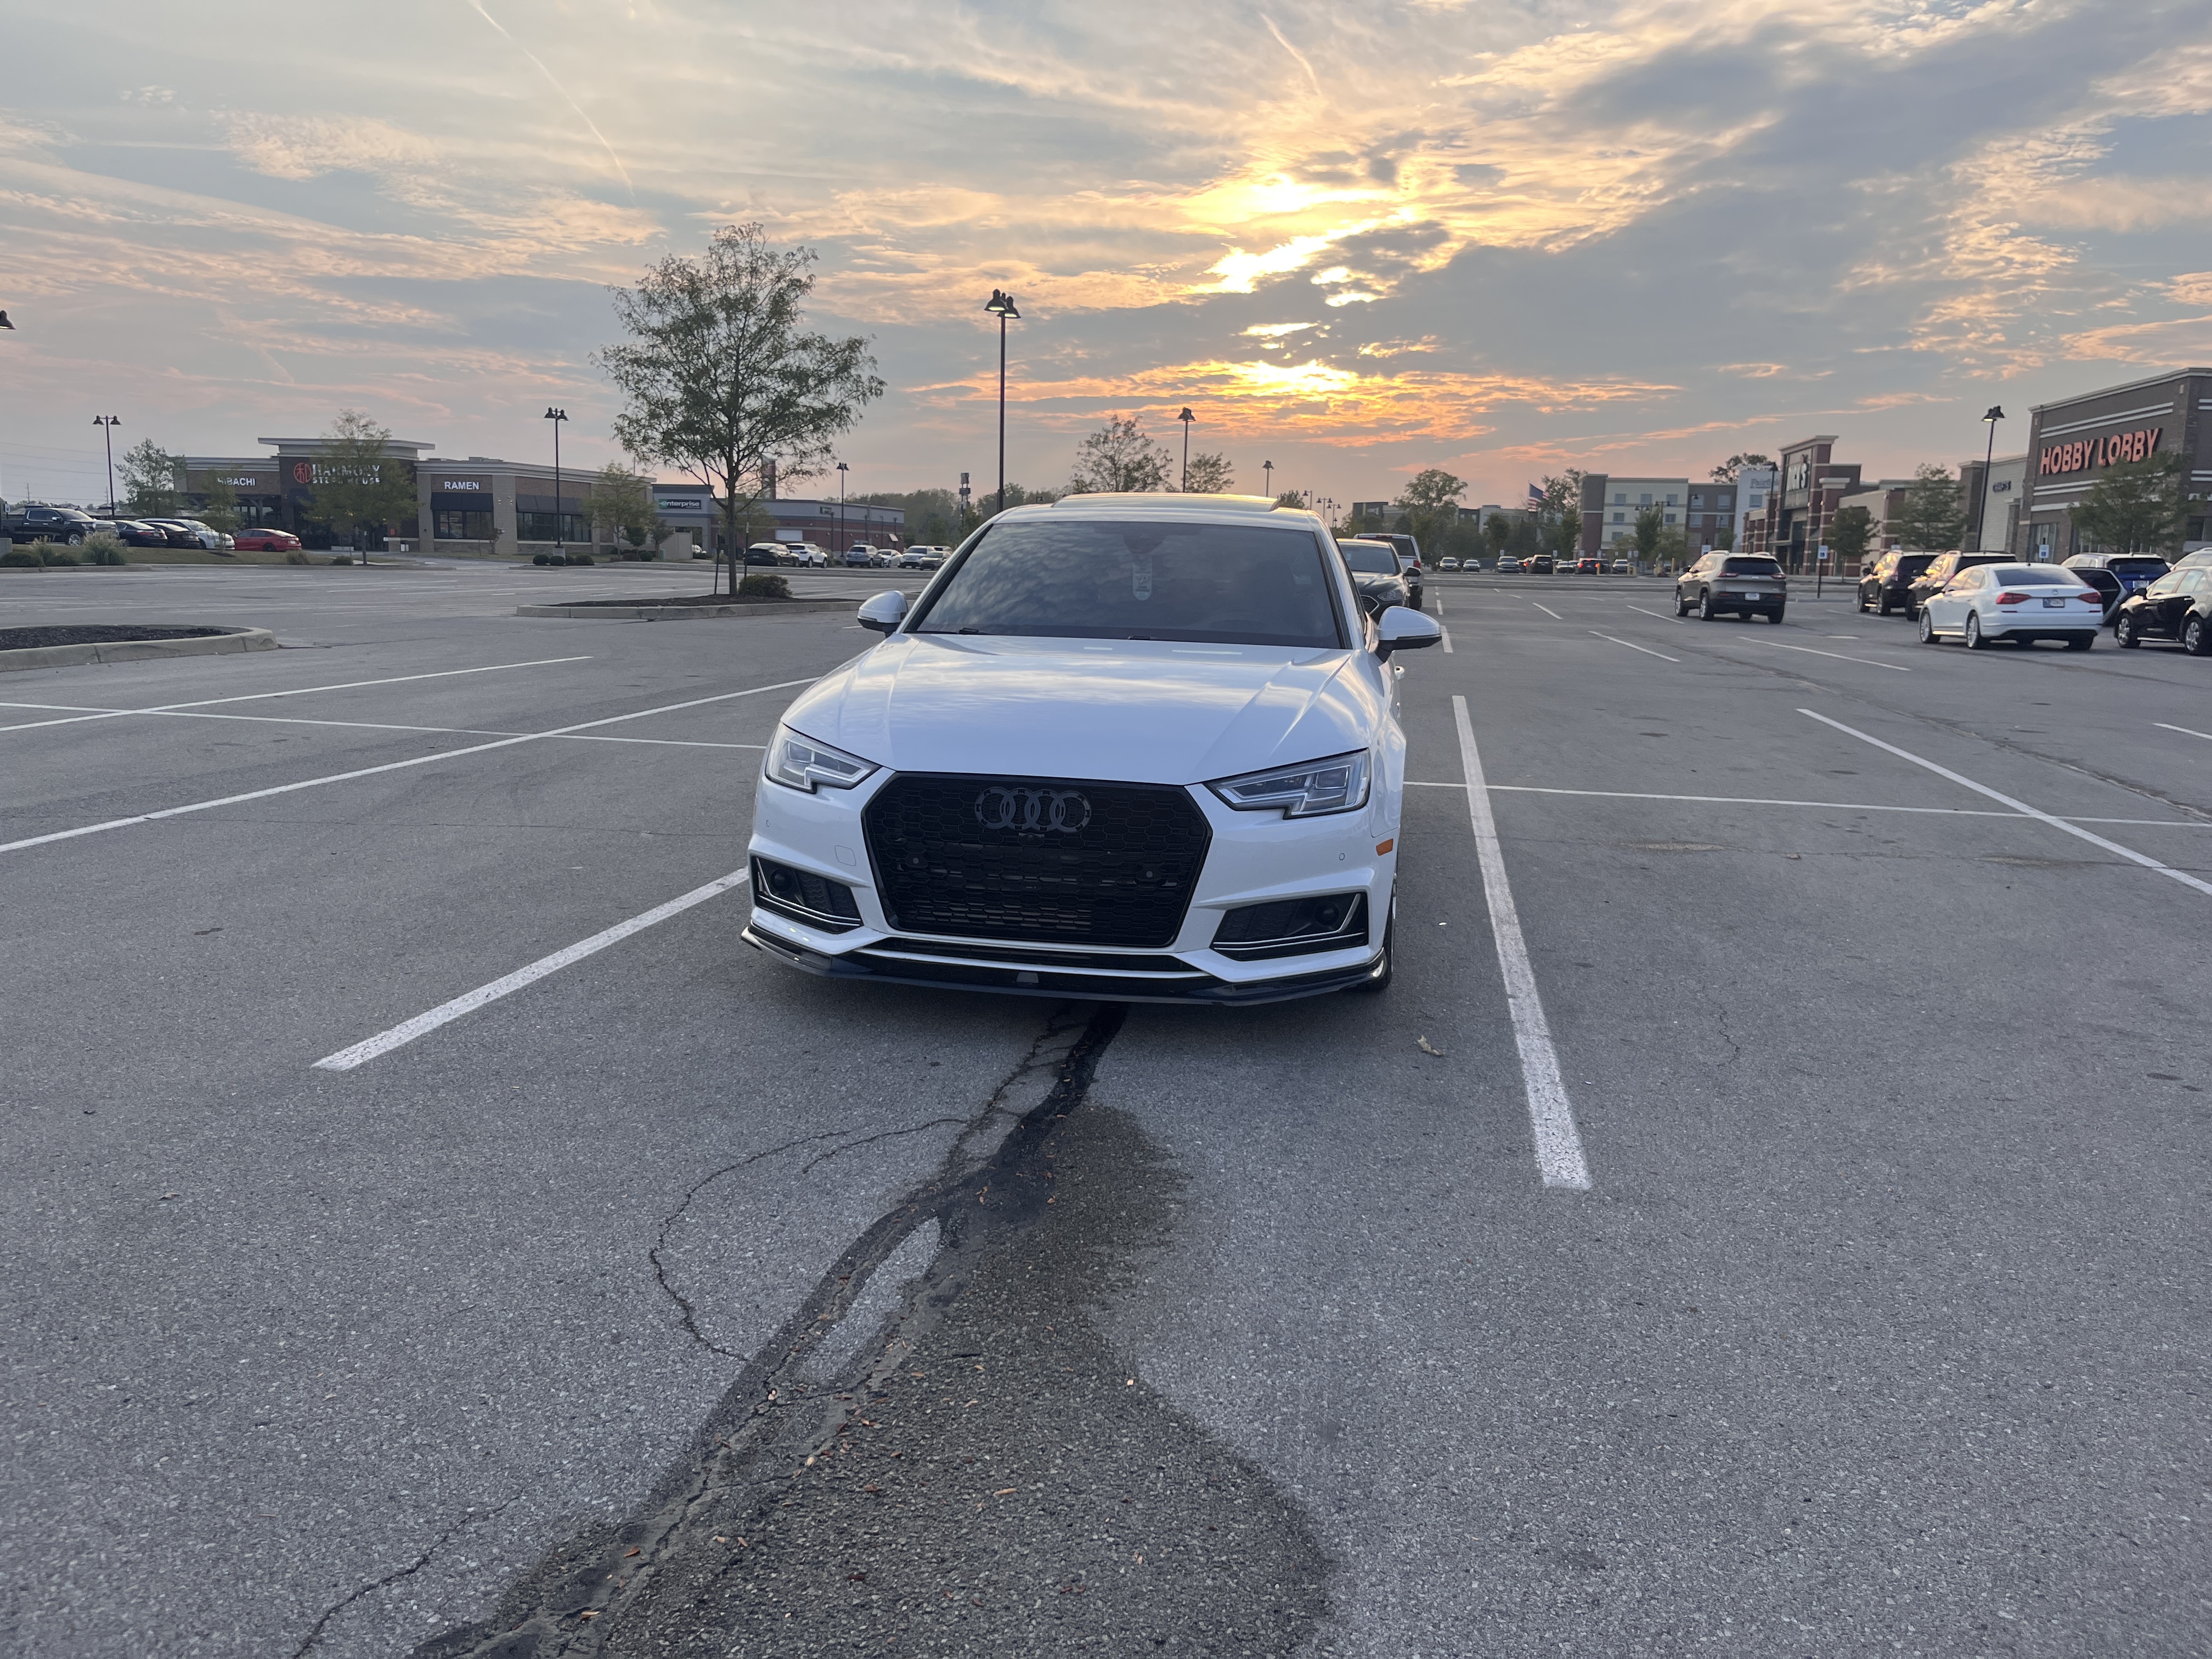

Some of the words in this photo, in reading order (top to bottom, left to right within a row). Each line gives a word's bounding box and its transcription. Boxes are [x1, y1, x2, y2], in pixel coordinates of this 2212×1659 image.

[2040, 439, 2094, 475] HOBBY
[2098, 427, 2159, 466] LOBBY
[444, 481, 479, 490] RAMEN
